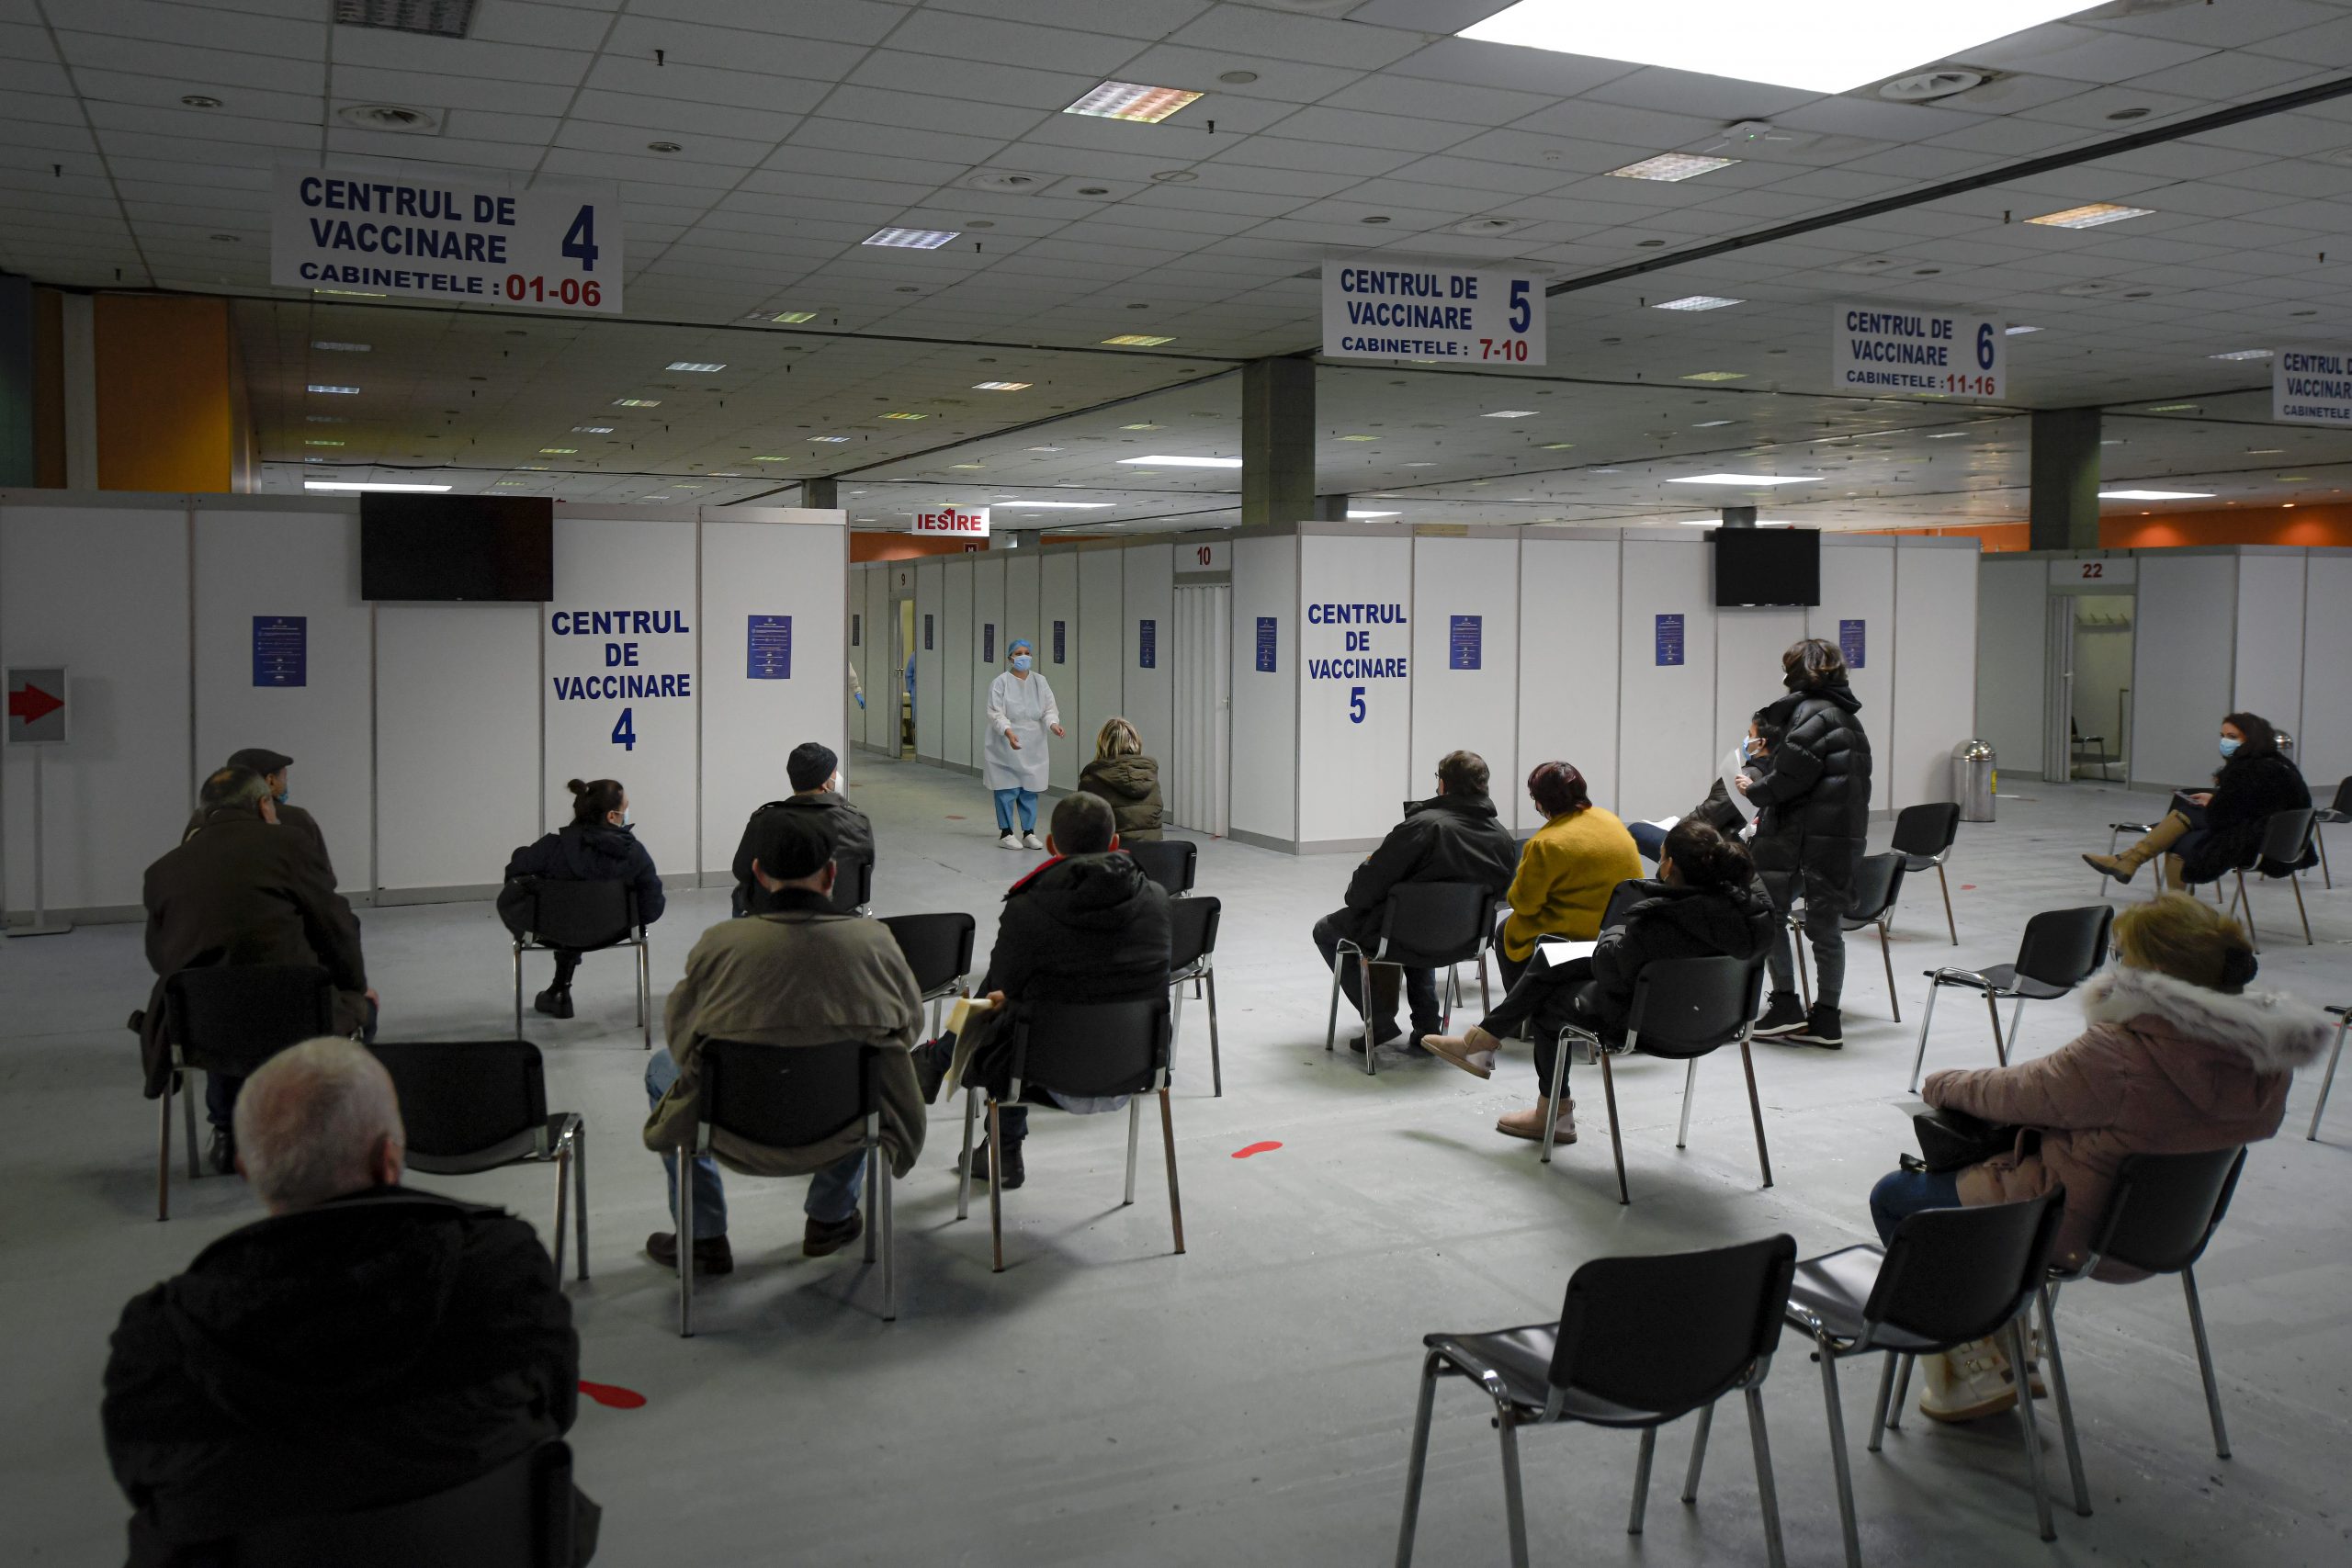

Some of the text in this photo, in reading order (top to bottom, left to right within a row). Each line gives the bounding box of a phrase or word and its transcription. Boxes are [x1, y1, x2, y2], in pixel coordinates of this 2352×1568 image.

[300, 176, 516, 226] CENTRUL DE
[310, 218, 507, 265] VACCINARE
[561, 204, 599, 272] 4
[506, 274, 602, 308] 01-06
[1340, 268, 1478, 299] CENTRUL DE
[1347, 300, 1473, 331] VACCINARE
[1509, 279, 1532, 333] 5
[1847, 310, 1953, 340] CENTRUL DE
[1479, 338, 1529, 363] 7-10
[1851, 339, 1949, 367] VACCINARE
[1976, 322, 1995, 371] 6
[2283, 353, 2343, 375] CENTRUL
[1946, 374, 1996, 397] 11-16
[2287, 378, 2352, 400] VACCINAR
[2283, 404, 2351, 419] CABINETELE
[1196, 546, 1212, 566] 10
[900, 572, 906, 586] 9
[2082, 562, 2103, 579] 22
[551, 610, 690, 636] CENTRUL
[1307, 604, 1408, 625] CENTRUL
[605, 642, 639, 667] DE
[1345, 630, 1370, 652] DE
[1308, 658, 1408, 680] VACCINARE
[553, 673, 691, 701] VACCINARE
[1349, 686, 1366, 724] 5
[611, 707, 637, 751] 4
